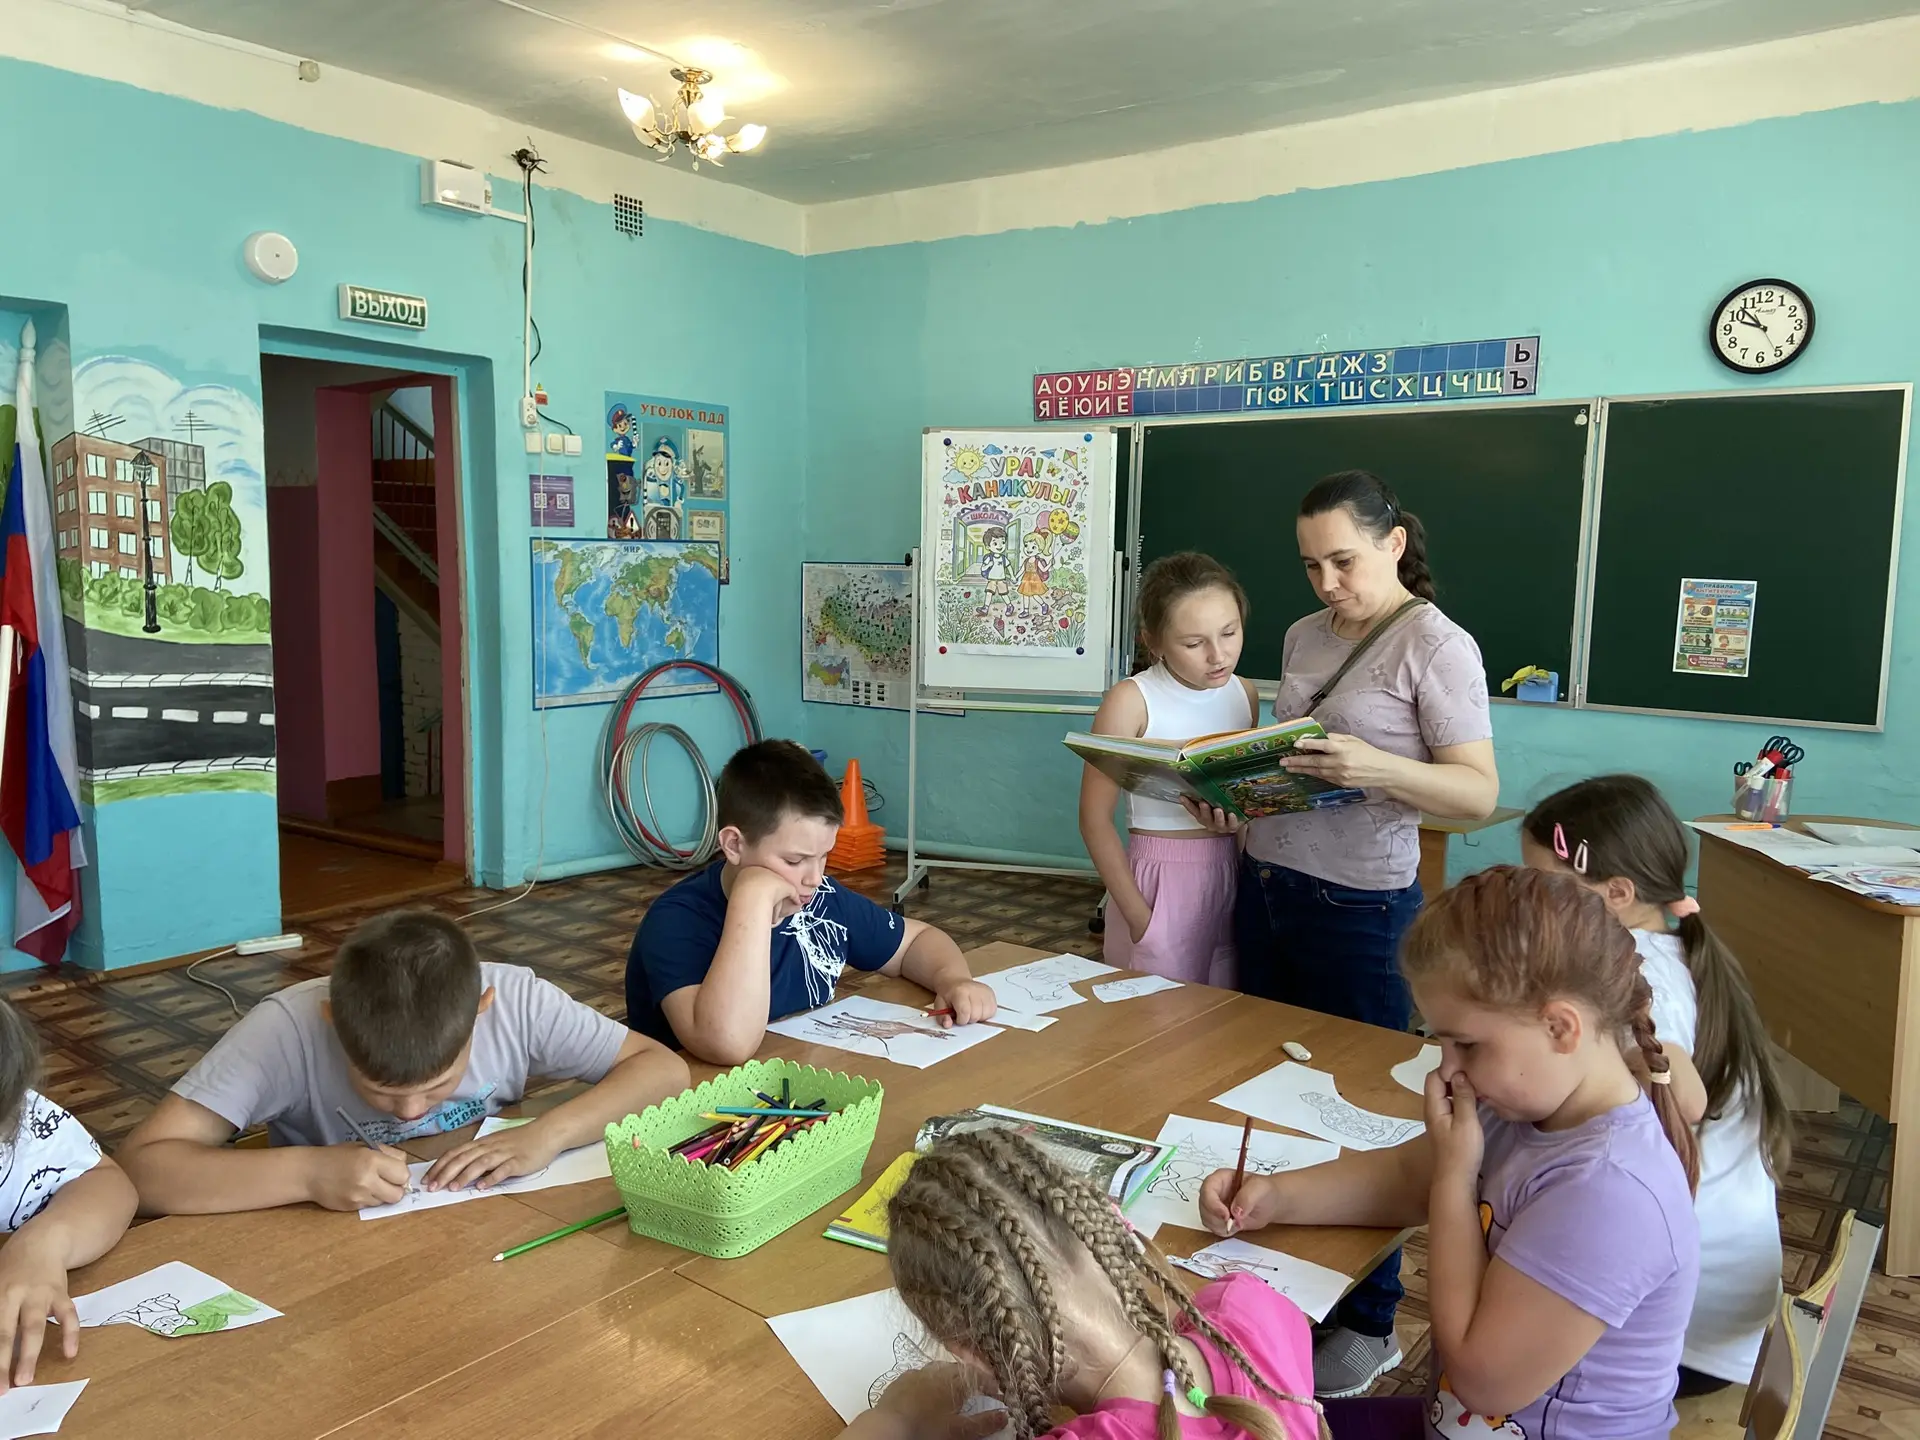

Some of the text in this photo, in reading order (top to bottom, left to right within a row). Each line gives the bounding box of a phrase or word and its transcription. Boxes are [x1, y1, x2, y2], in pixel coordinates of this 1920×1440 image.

[1742, 296, 1757, 309] 11
[1756, 290, 1774, 304] 12
[1778, 294, 1786, 307] 1
[355, 290, 423, 325] ВЫХОД
[1787, 305, 1797, 318] 2
[1729, 309, 1745, 322] 10
[1723, 323, 1732, 336] 9
[1793, 318, 1803, 331] 3
[1727, 336, 1737, 349] 8
[1785, 332, 1795, 345] 4
[1739, 347, 1749, 360] 7
[1755, 351, 1765, 364] 6
[1773, 345, 1783, 358] 5
[640, 403, 725, 425] УГОЛОК ПДД
[990, 455, 1044, 478] УРА!
[957, 478, 1078, 508] КАНИКУЛЫ!
[970, 512, 1000, 521] ШКОЛА
[622, 545, 641, 553] МИР
